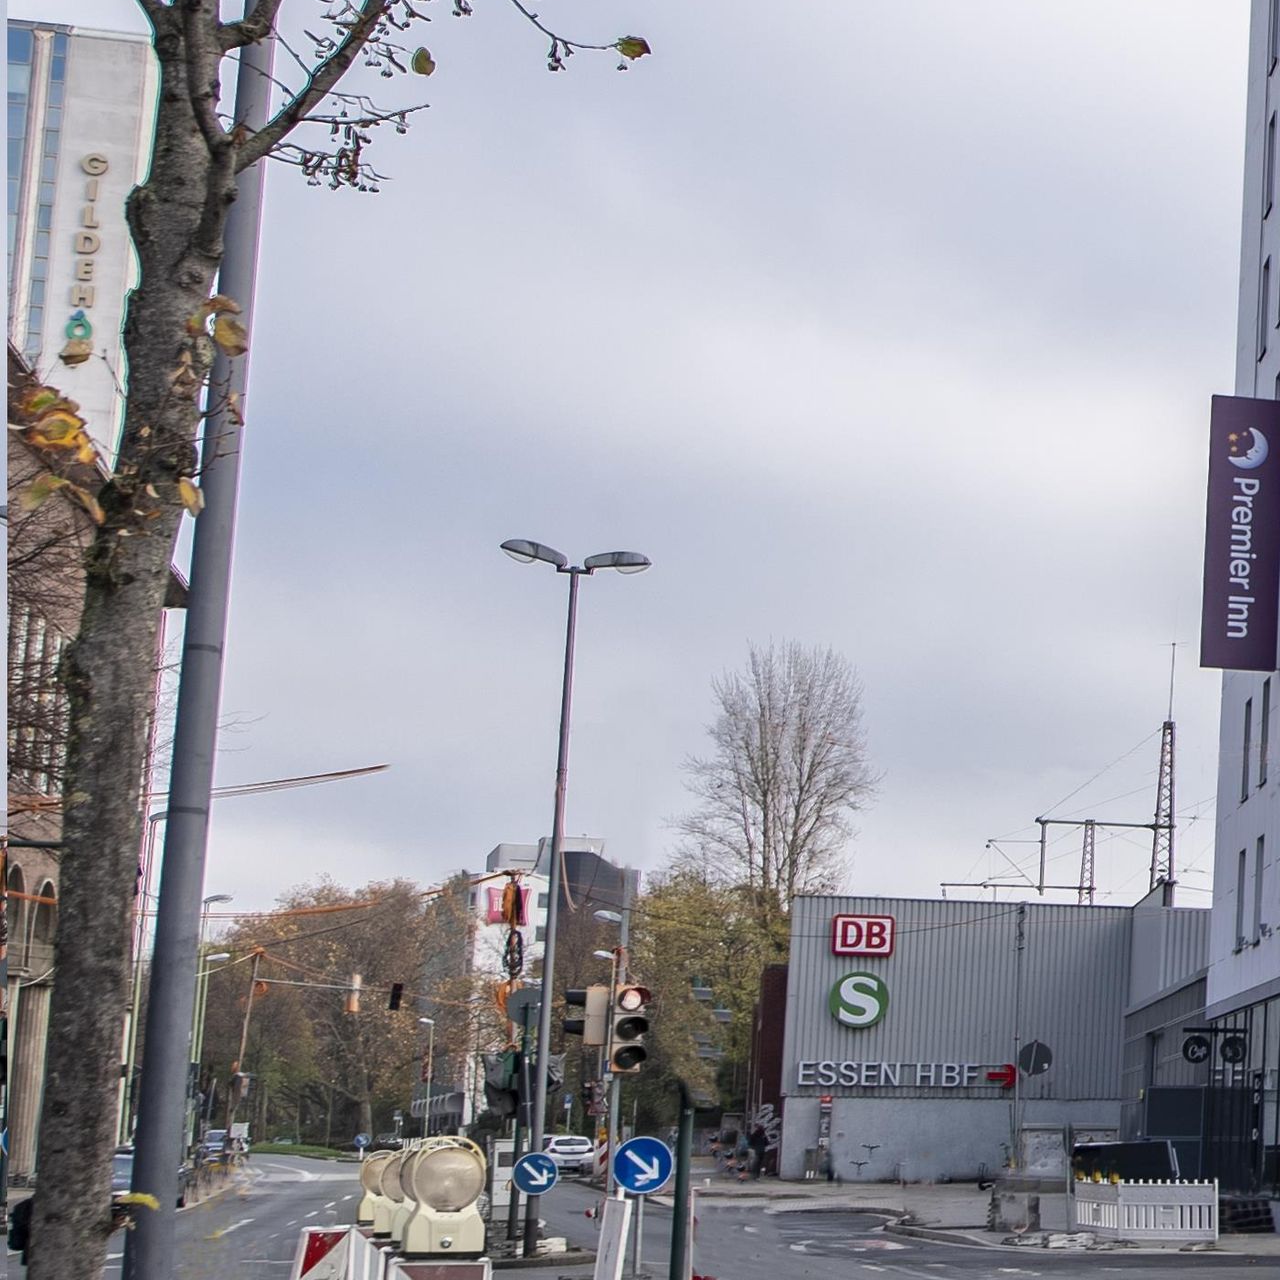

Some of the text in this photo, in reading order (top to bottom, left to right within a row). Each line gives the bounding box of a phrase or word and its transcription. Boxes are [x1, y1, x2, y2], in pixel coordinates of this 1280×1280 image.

[65, 153, 108, 340] GILDEHO
[1226, 477, 1261, 638] Premier Inn
[840, 921, 887, 949] DB
[838, 976, 881, 1025] S
[797, 1060, 980, 1087] ESSEN HBF
